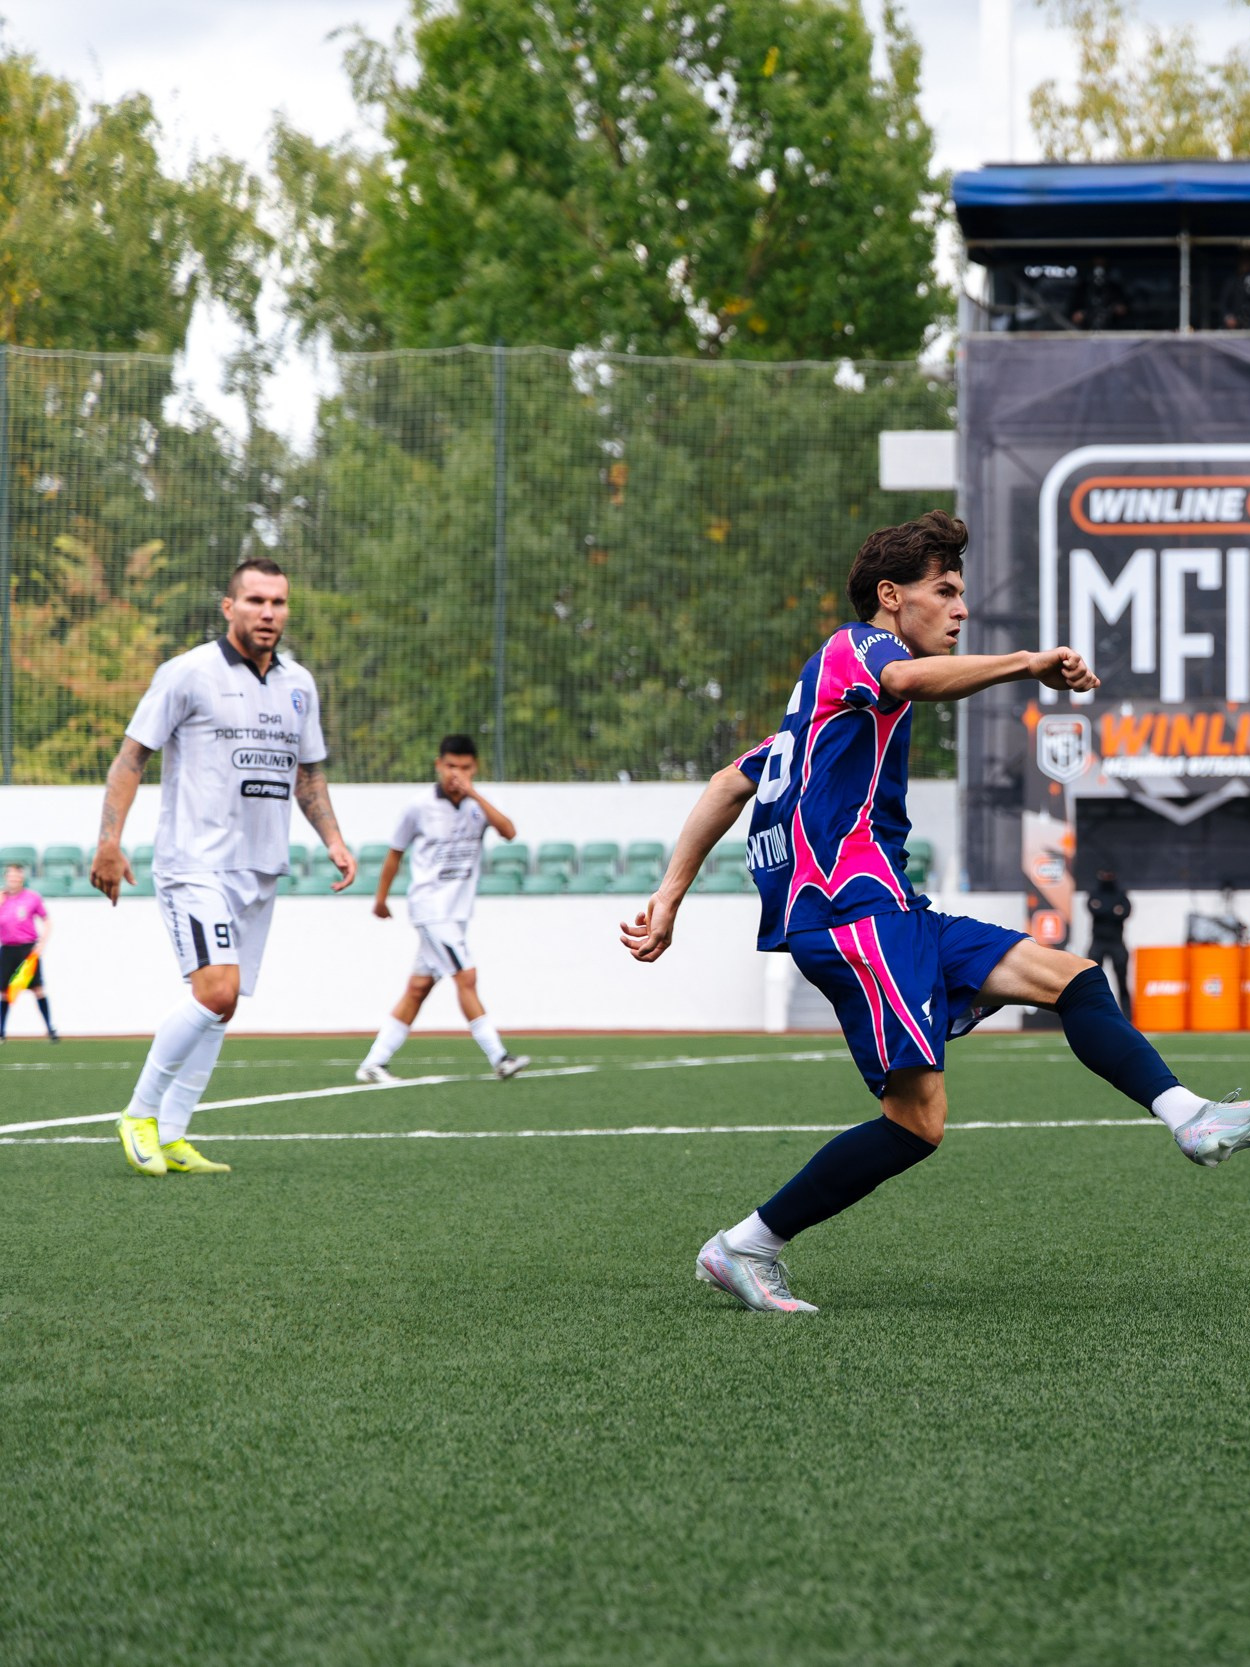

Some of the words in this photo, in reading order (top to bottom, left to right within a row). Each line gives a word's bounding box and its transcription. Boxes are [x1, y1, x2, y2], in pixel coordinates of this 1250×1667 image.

[1088, 488, 1246, 523] WINLINE
[240, 753, 287, 768] WINLINE
[215, 923, 230, 948] 9
